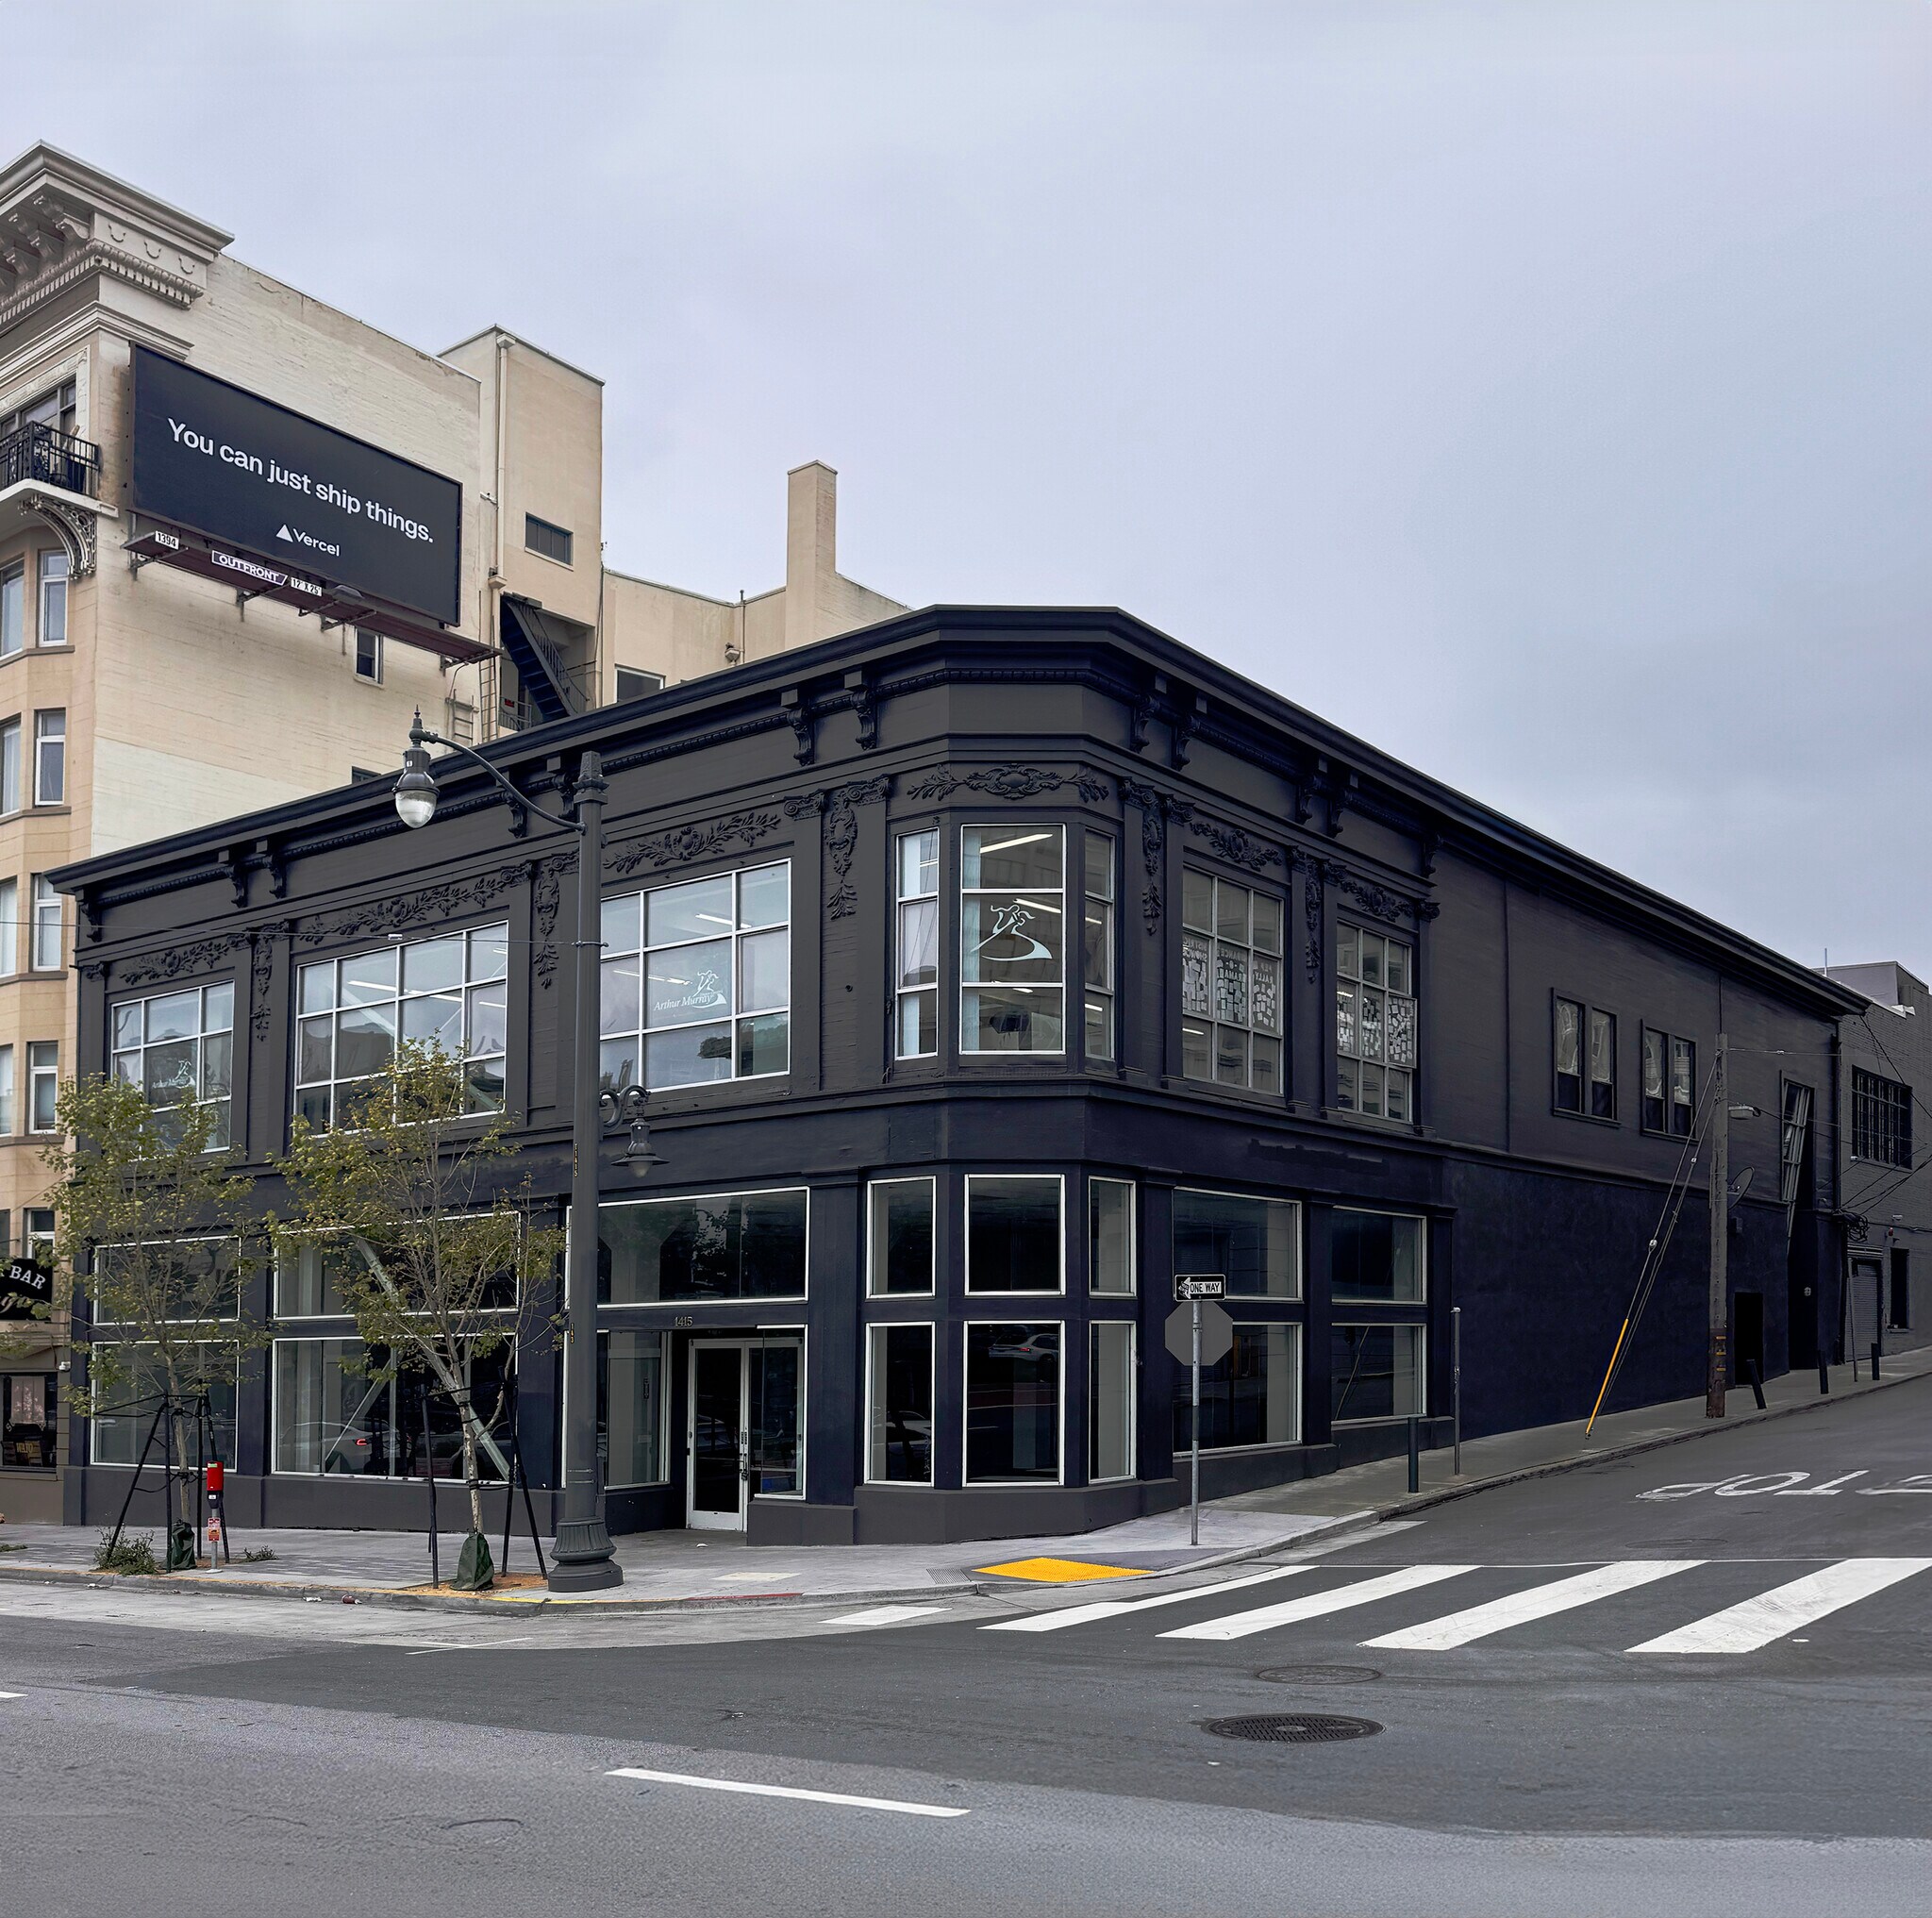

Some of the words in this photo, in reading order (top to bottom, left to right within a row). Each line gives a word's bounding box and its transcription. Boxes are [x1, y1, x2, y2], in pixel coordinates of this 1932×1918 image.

[168, 418, 214, 456] You
[220, 444, 263, 475] can
[267, 459, 311, 495] just
[315, 482, 361, 514] ship
[365, 500, 434, 542] things.
[158, 532, 176, 548] 1394
[292, 527, 341, 557] Vercel
[218, 555, 279, 582] OUTFRONT
[654, 998, 680, 1011] Arthur
[681, 995, 712, 1007] Murray
[8, 1264, 46, 1290] BAR
[1191, 1283, 1203, 1293] ONE
[1206, 1283, 1220, 1293] WAY
[674, 1316, 693, 1326] 1415
